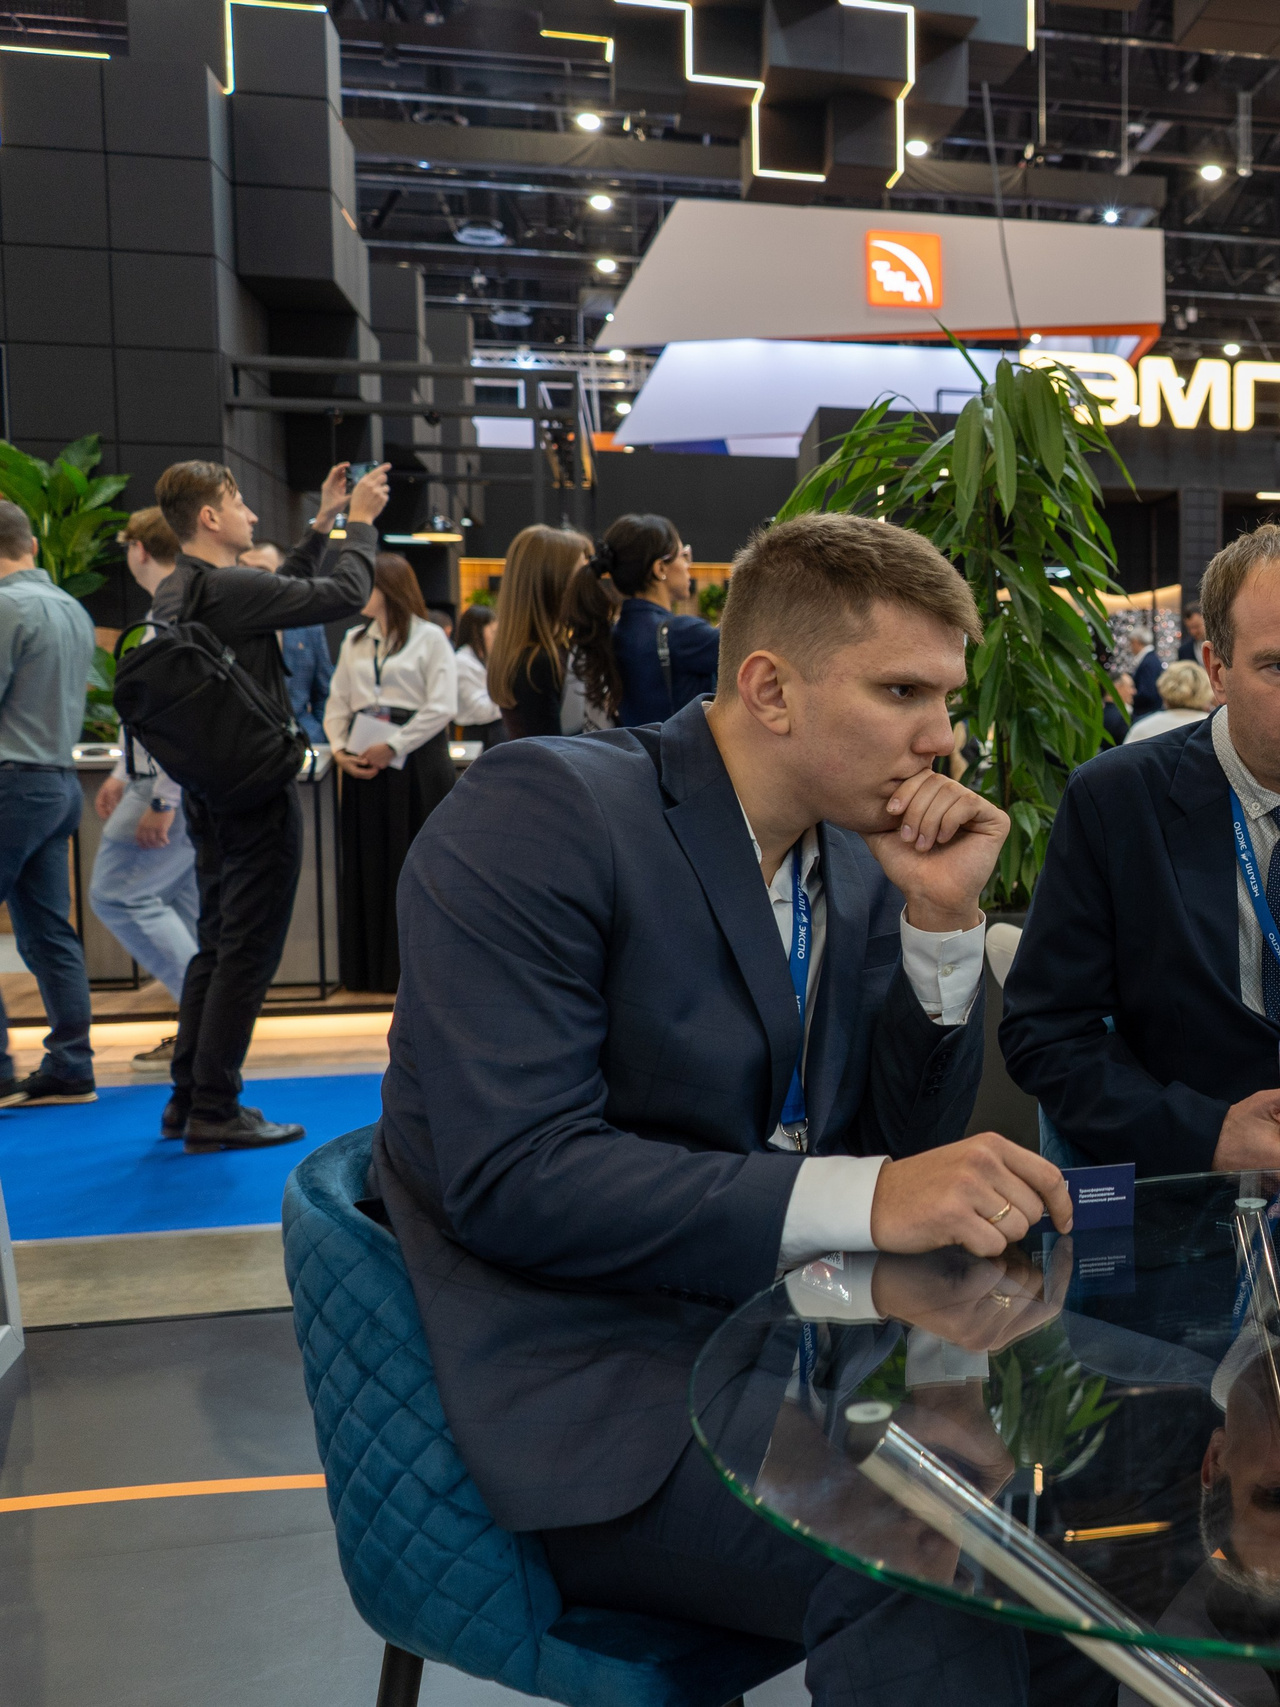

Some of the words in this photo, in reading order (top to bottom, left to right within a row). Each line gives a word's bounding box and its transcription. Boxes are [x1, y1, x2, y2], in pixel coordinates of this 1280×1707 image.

[1233, 821, 1248, 851] ЭКСПО
[1246, 862, 1260, 898] МЕТАЛЛ
[797, 924, 807, 960] ЭКСПО
